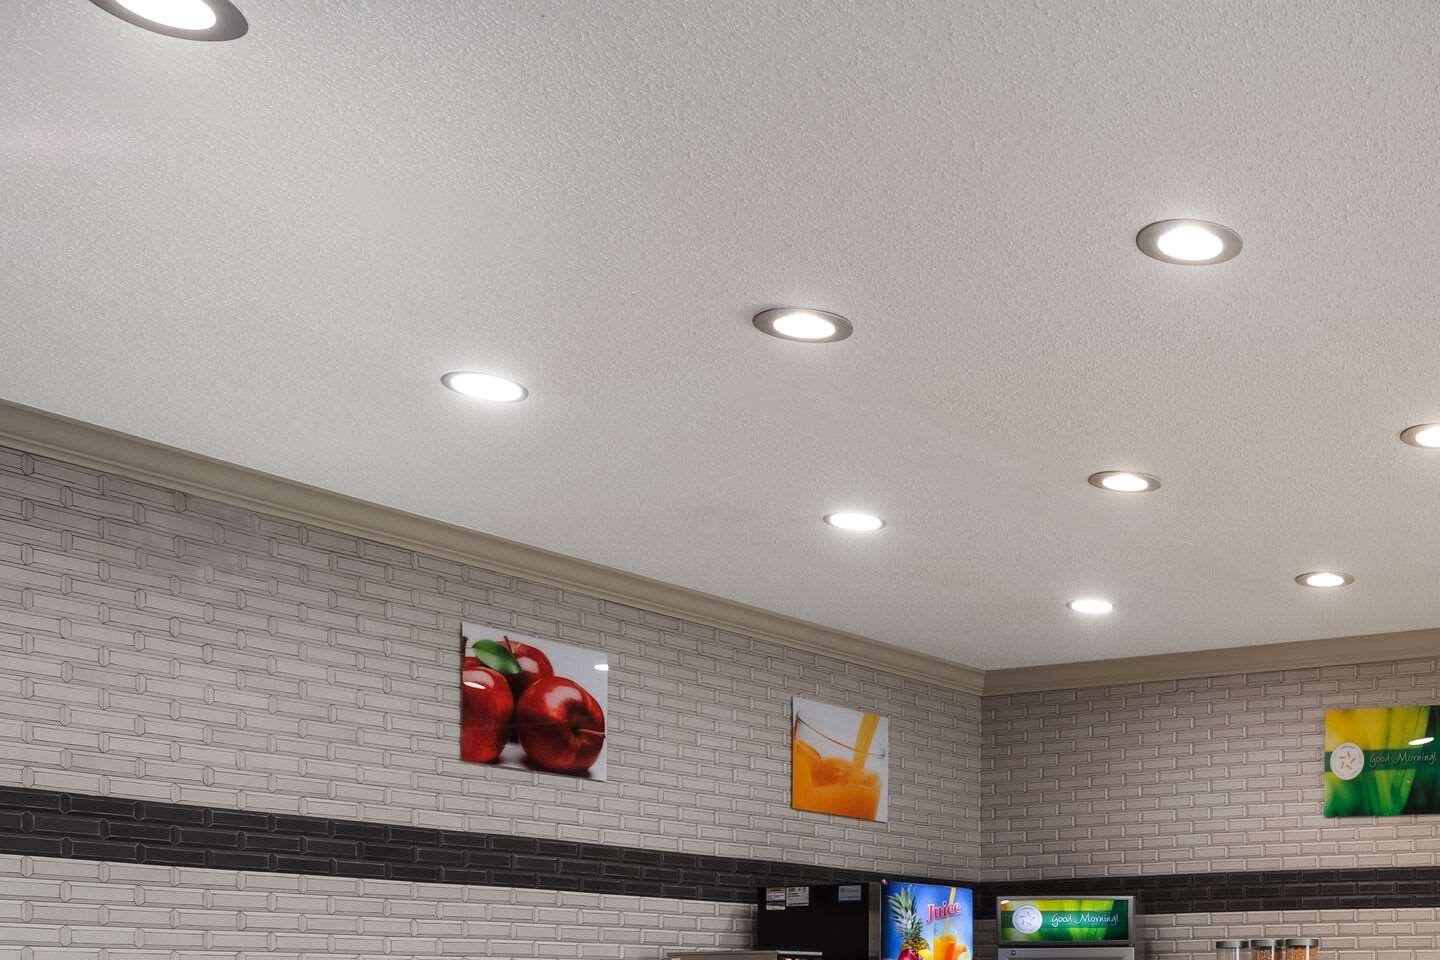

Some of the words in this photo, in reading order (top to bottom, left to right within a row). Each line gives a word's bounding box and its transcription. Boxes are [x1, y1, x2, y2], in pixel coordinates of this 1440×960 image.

[1369, 751, 1390, 768] Good
[926, 901, 962, 923] Juice
[1050, 912, 1073, 928] Good
[1074, 912, 1119, 926] Morning!
